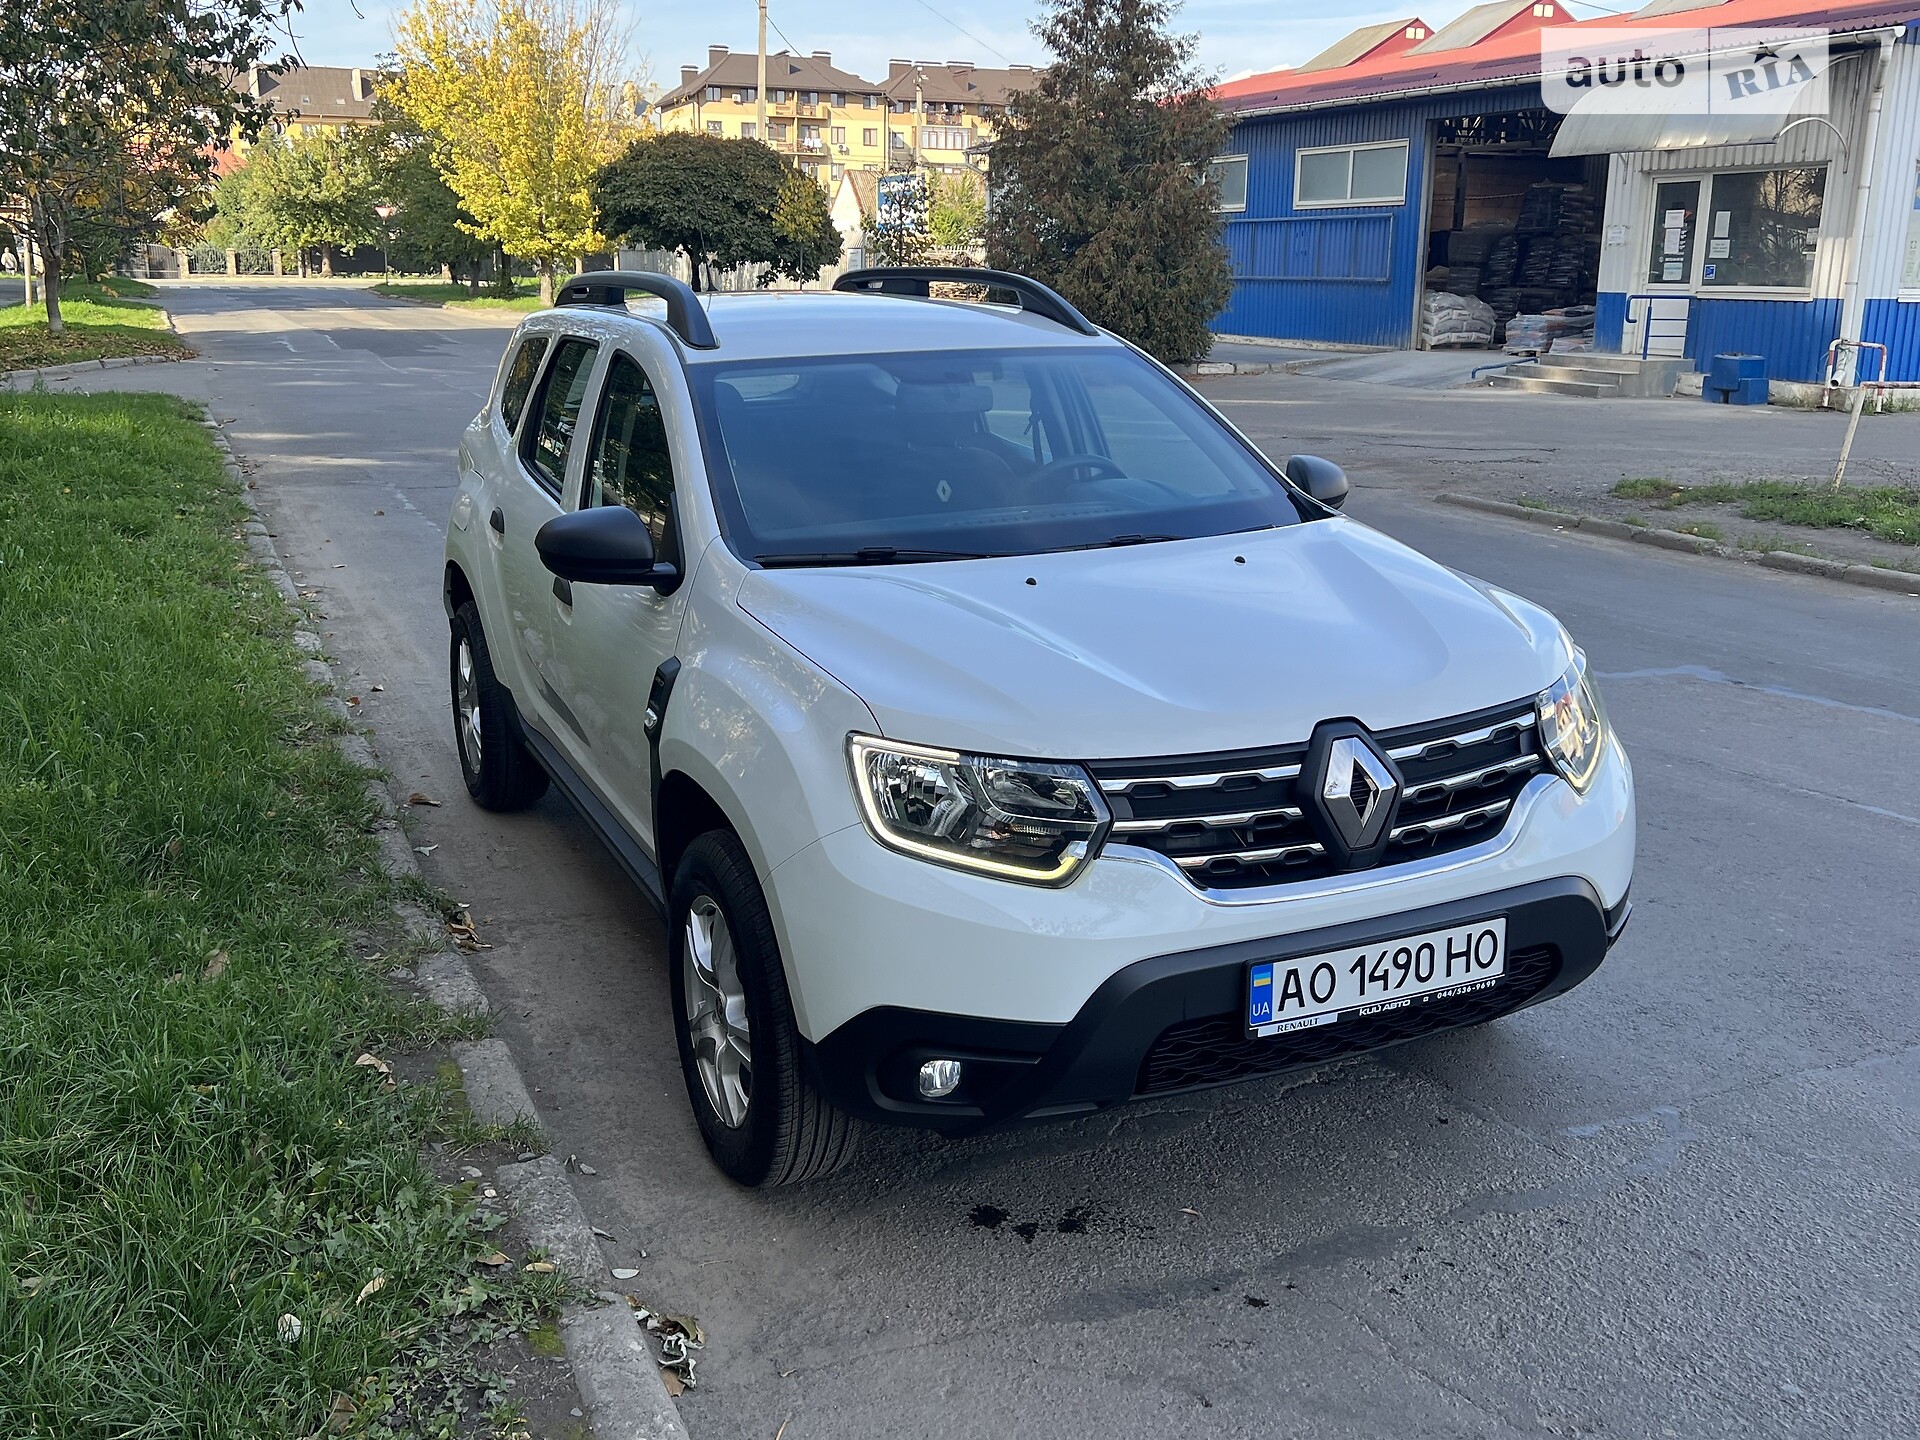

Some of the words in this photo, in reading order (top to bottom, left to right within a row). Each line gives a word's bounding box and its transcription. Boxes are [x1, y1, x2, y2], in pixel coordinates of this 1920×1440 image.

[1348, 941, 1436, 996] 1490
[1436, 979, 1497, 999] 044/536-9699
[1252, 1003, 1270, 1017] UA
[1276, 1016, 1320, 1033] RENAULT
